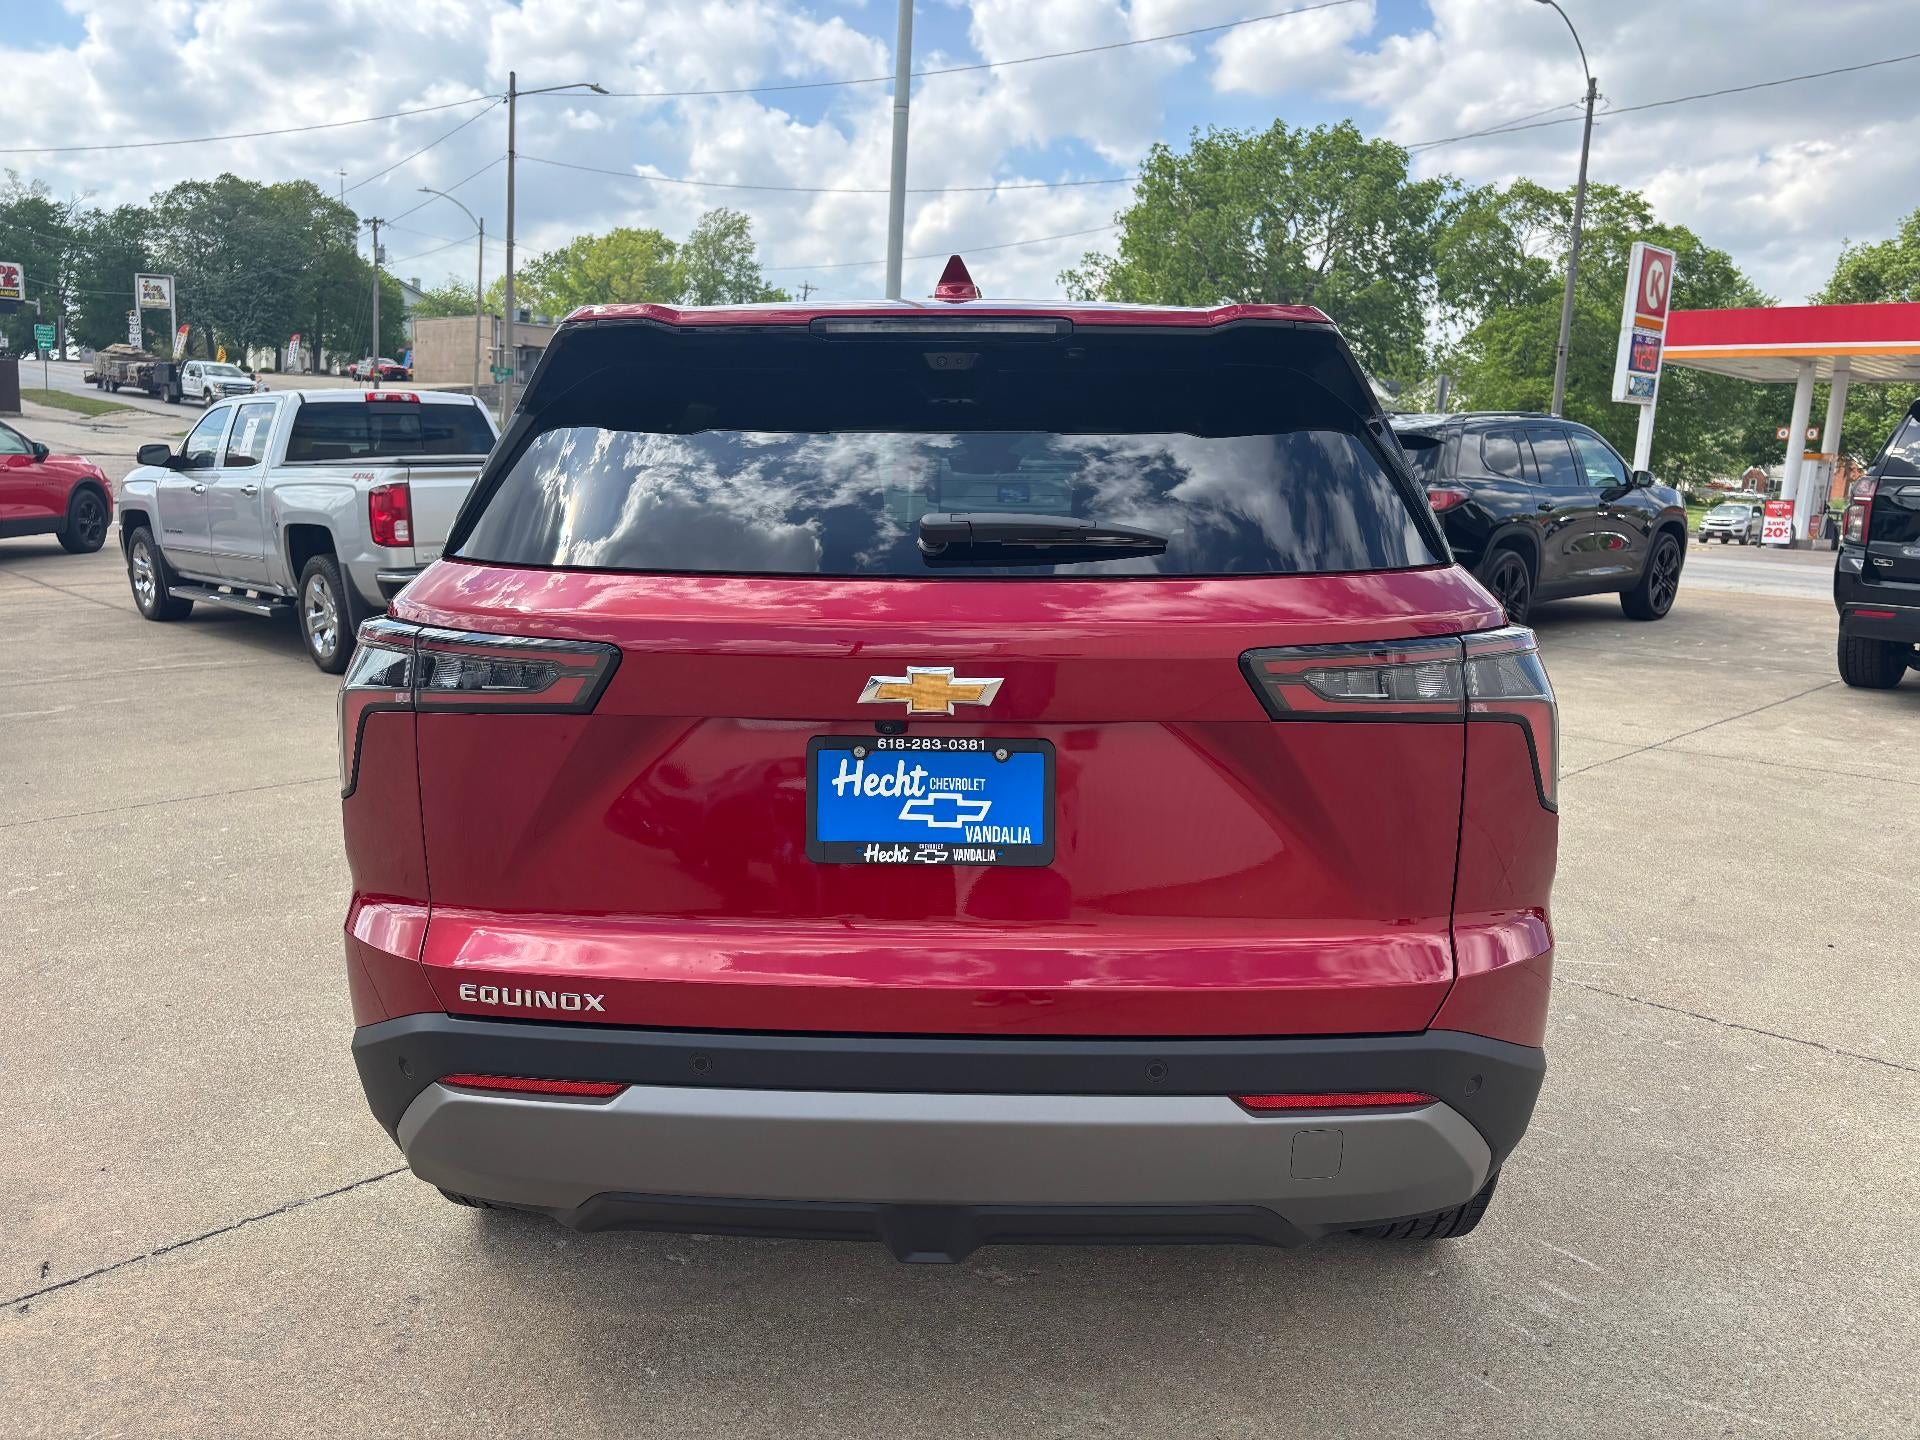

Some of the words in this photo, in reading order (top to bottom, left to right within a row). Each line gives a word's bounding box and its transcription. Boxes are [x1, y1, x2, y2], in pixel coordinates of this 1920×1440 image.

[877, 738, 986, 751] 618-283-0381
[831, 758, 928, 797] Hecht
[929, 777, 986, 791] CHEVROLET
[965, 825, 1032, 844] VANDALIA
[863, 843, 911, 863] Hecht
[953, 848, 996, 862] VANDALIA
[459, 983, 606, 1012] EQUINOX
